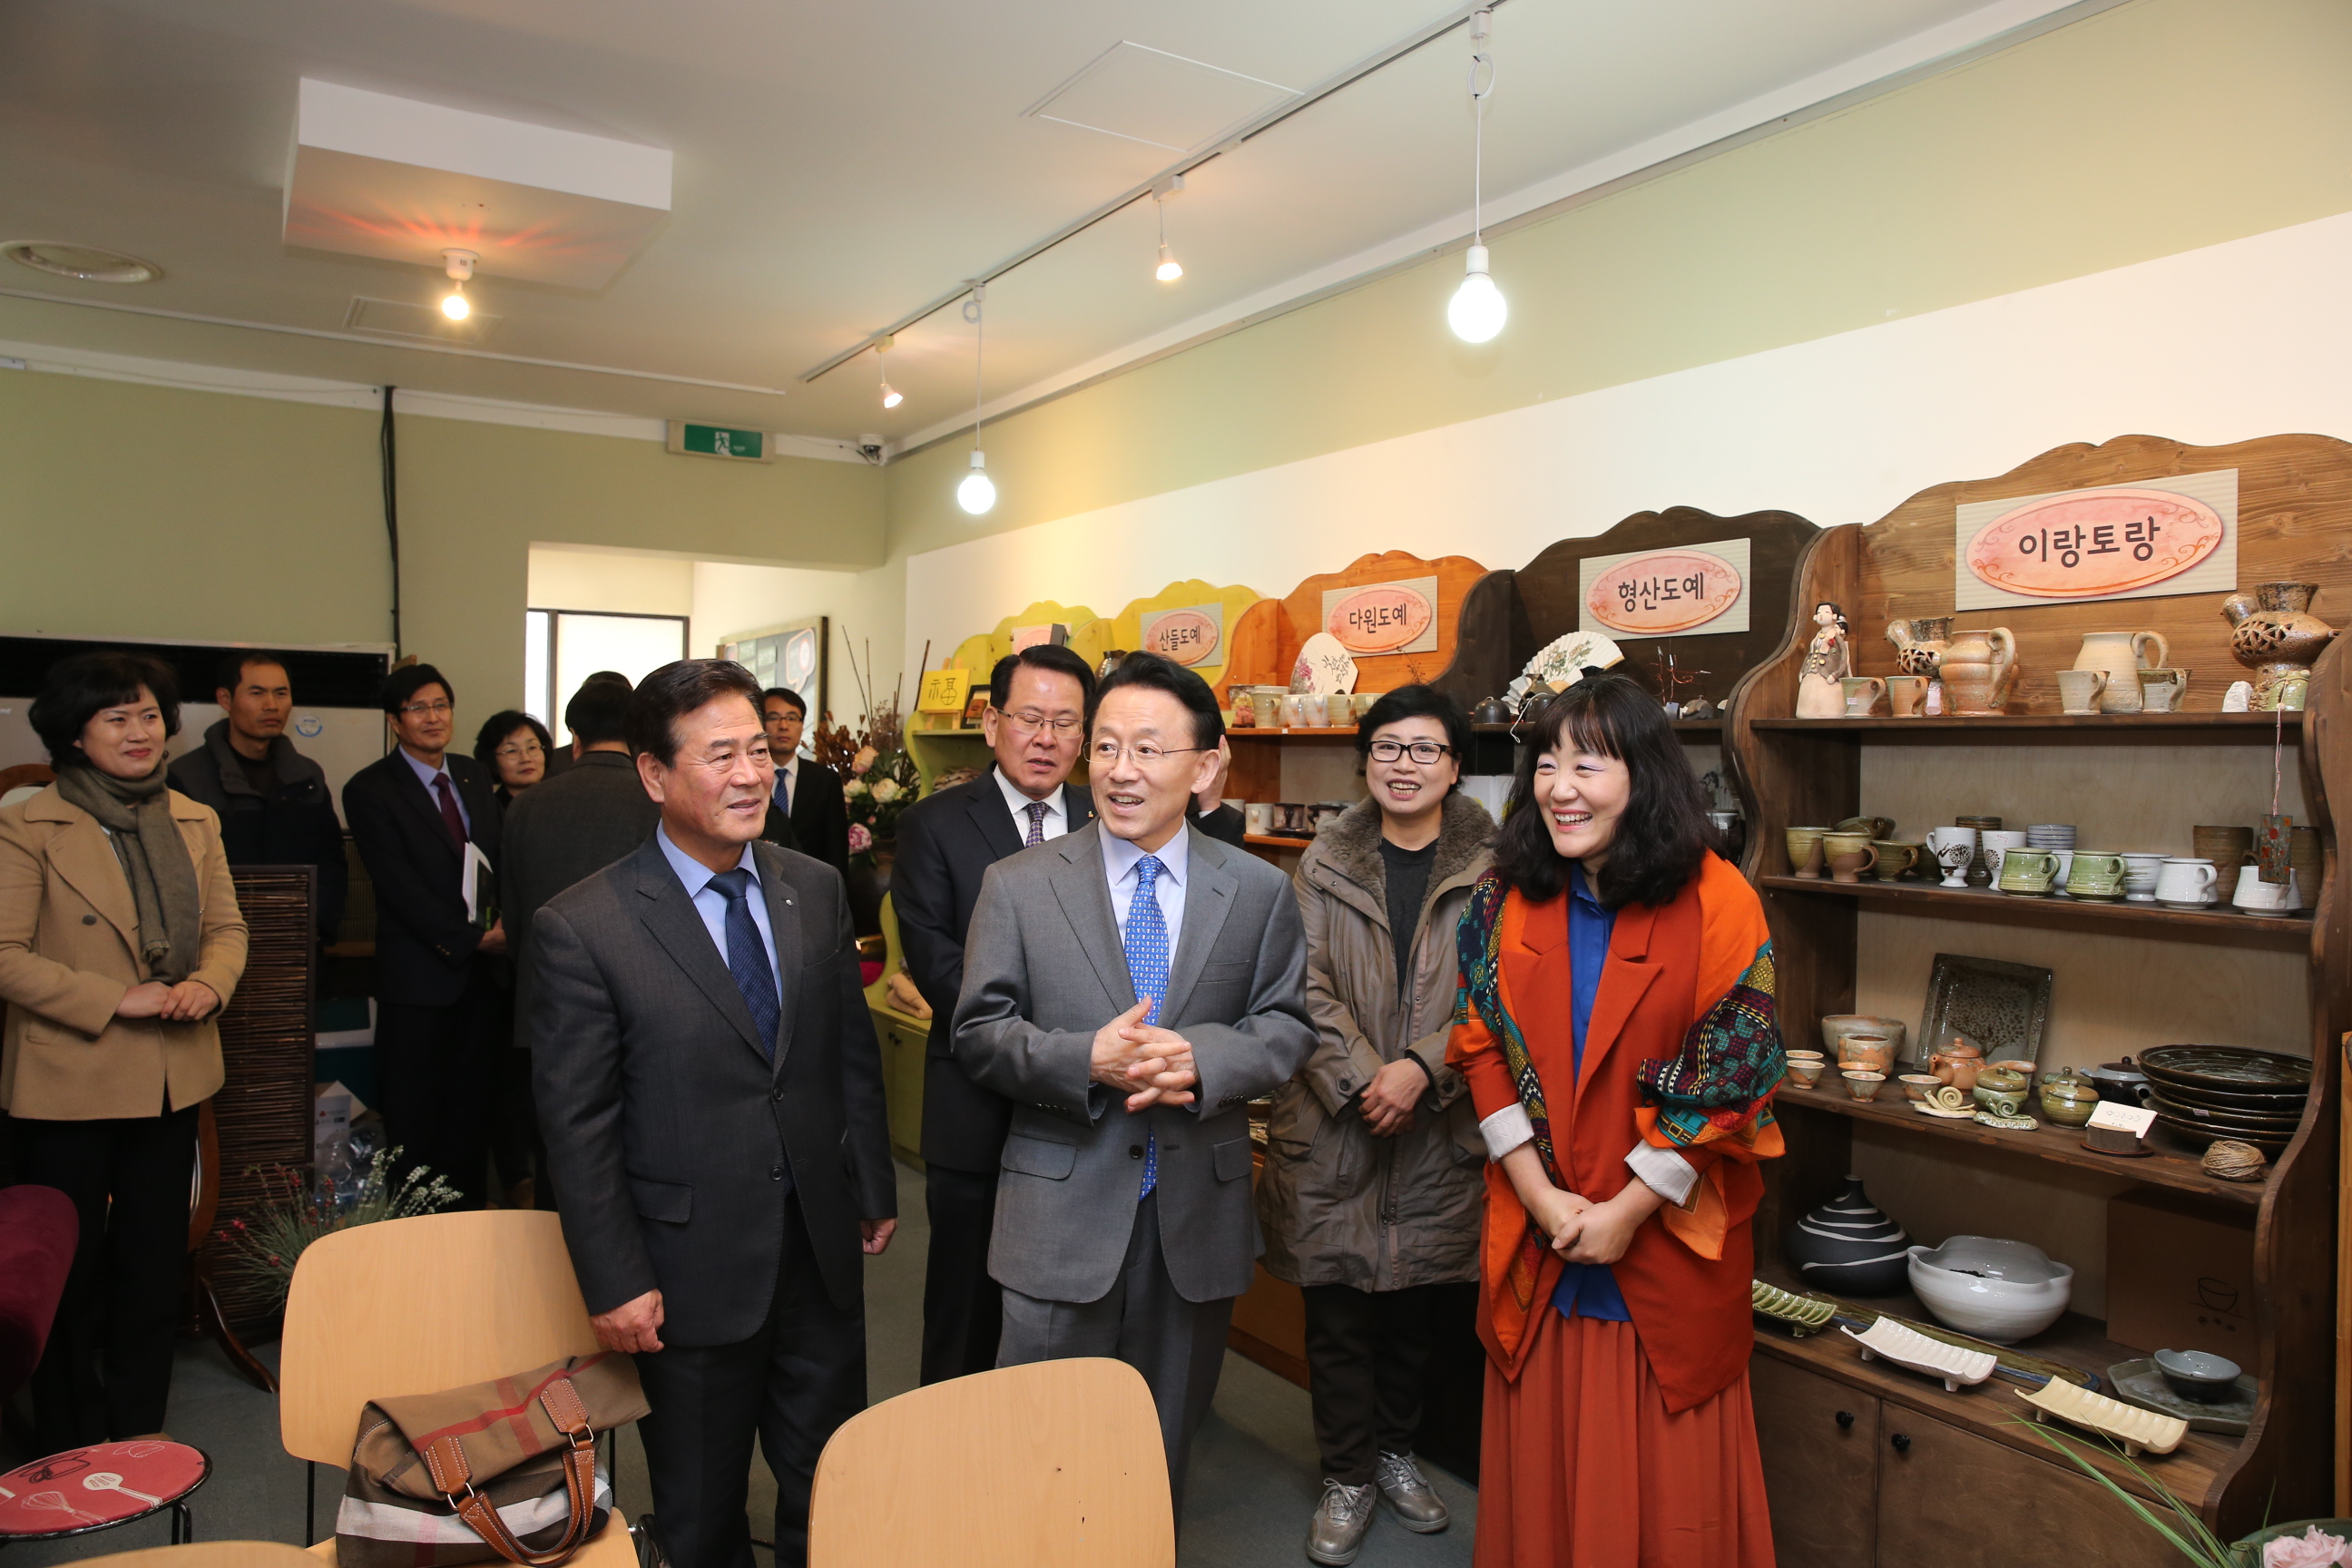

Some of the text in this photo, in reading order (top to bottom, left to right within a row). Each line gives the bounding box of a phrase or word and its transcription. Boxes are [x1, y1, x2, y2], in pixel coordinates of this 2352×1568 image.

[2019, 515, 2161, 568] 이랑토랑
[1618, 572, 1704, 612] 형산도예
[1349, 603, 1406, 634] 다원도예
[1160, 625, 1200, 651] 산들도예
